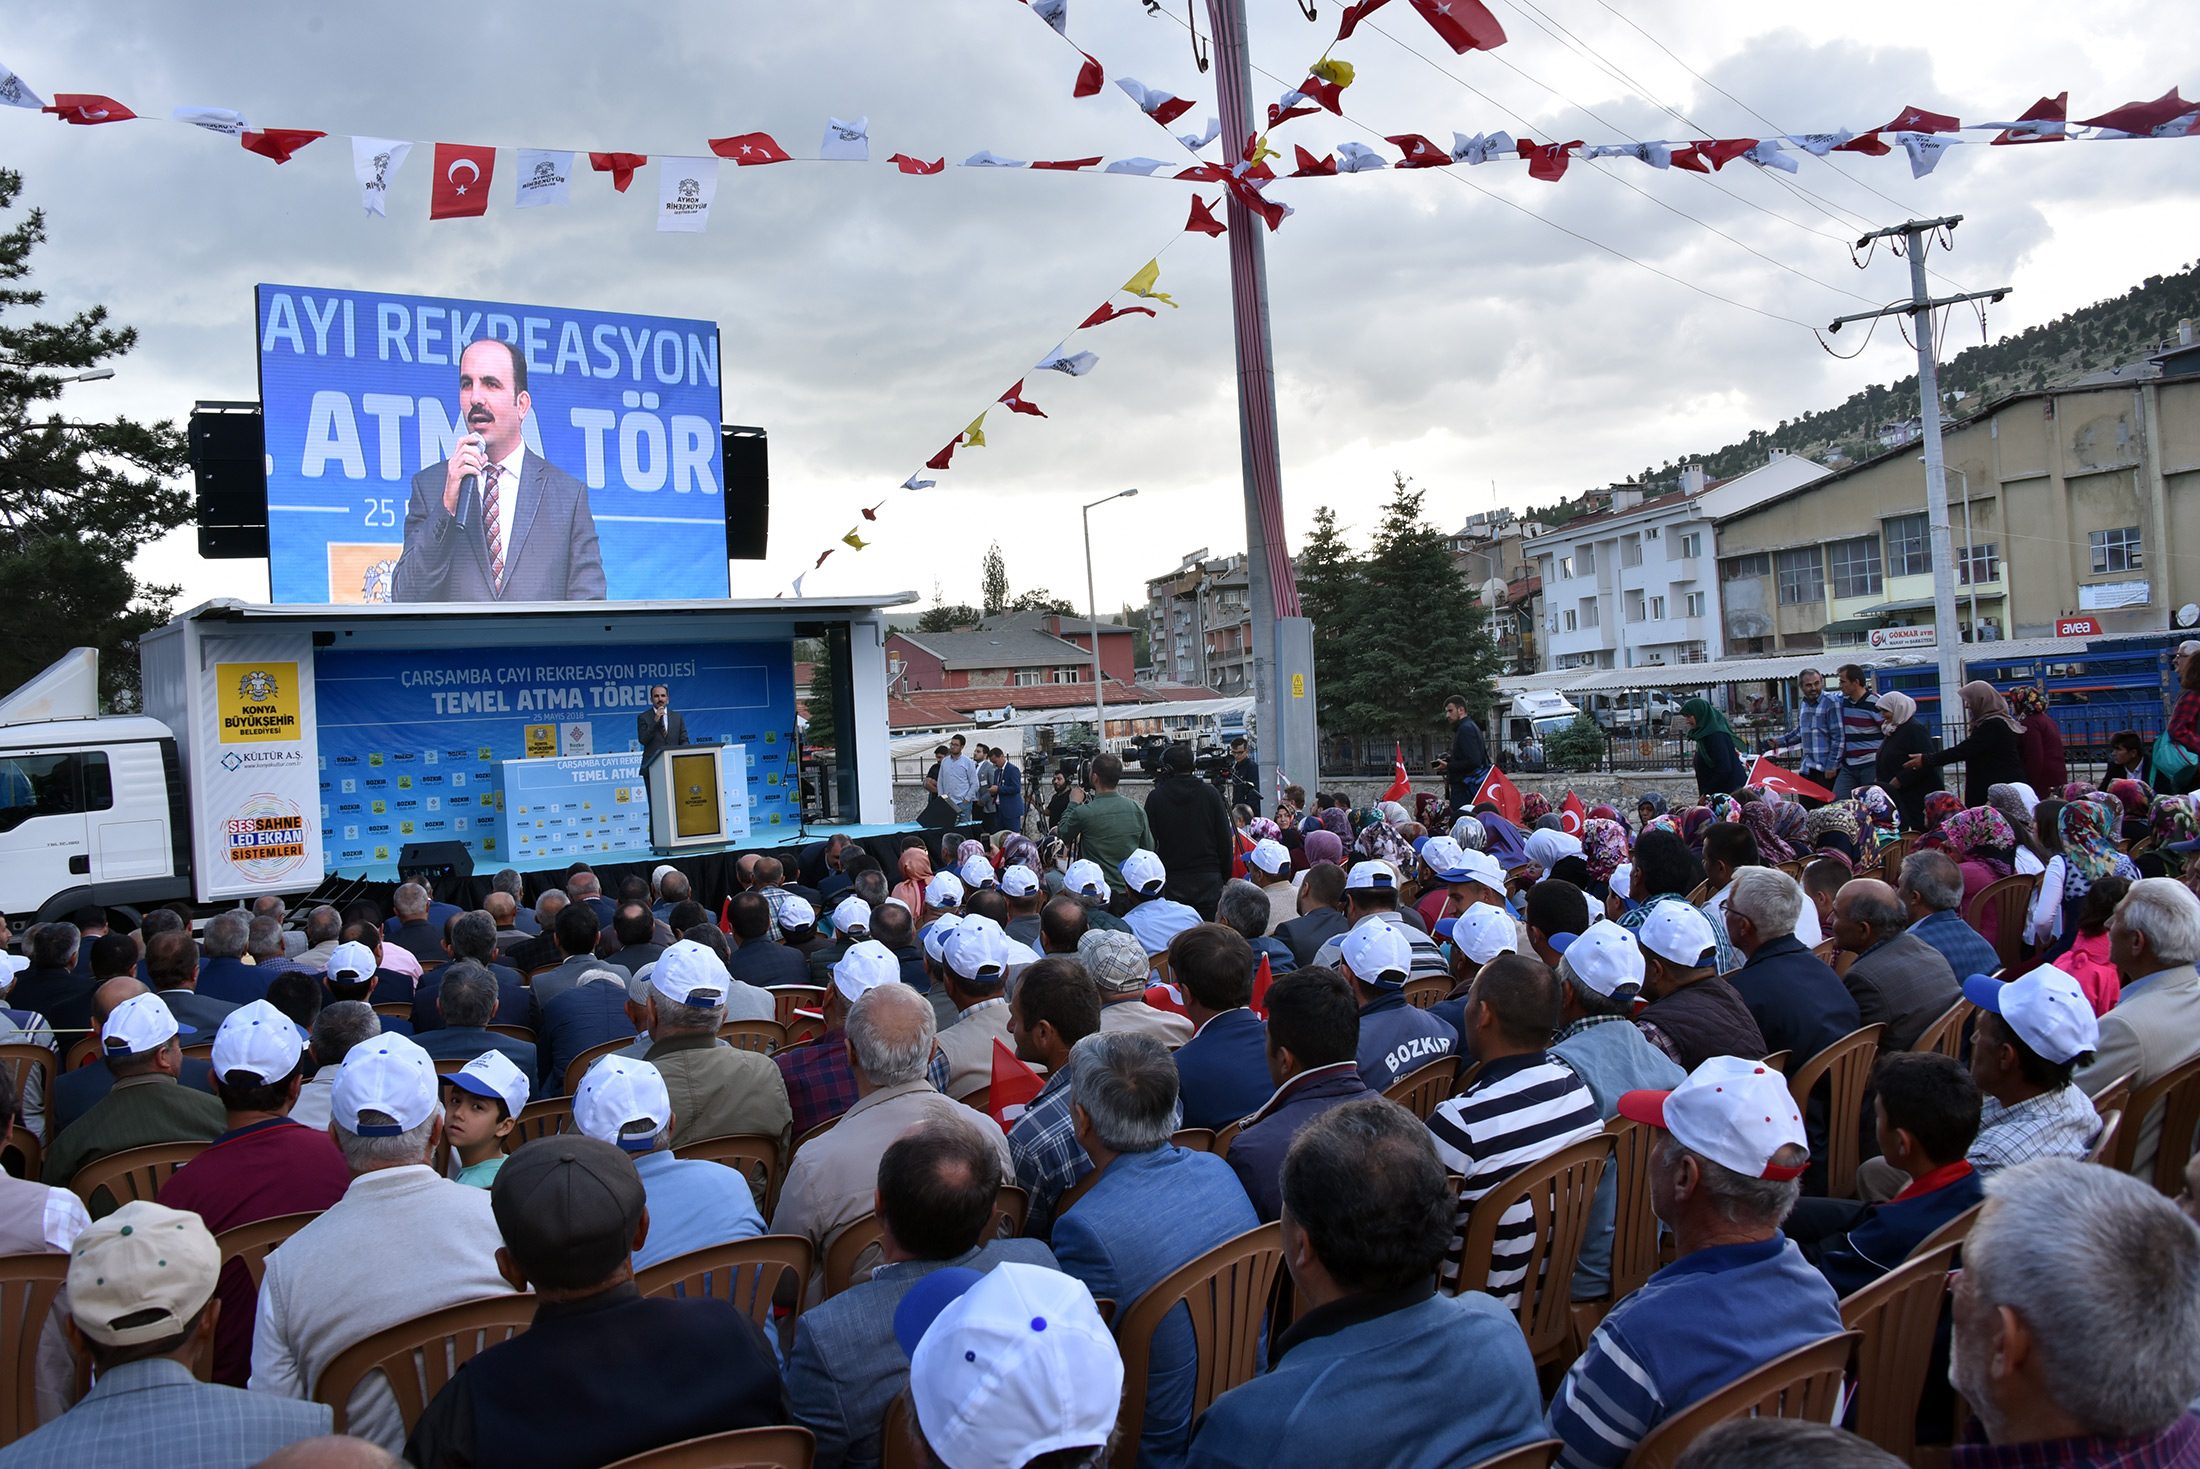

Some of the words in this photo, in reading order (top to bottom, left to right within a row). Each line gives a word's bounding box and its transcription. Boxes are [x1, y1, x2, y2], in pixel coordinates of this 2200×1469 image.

[262, 293, 357, 357] AYI
[570, 389, 719, 494] TÖR
[364, 498, 397, 528] 25
[1888, 630, 1918, 639] GÖKMAR
[2062, 622, 2091, 634] avea
[401, 668, 493, 688] ÇARŞAMBA
[496, 667, 532, 686] ÇAYI
[536, 664, 634, 682] REKREASYON
[639, 659, 696, 678] PROJESİ
[432, 690, 511, 715] TEMEL
[516, 687, 585, 711] ATMA
[242, 705, 277, 715] KONYA
[224, 714, 295, 728] BÜYÜKŞEHİR
[533, 714, 542, 722] 25
[544, 712, 565, 720] MAYIS
[566, 712, 584, 720] 2018
[240, 726, 282, 736] BELEDİYESİ
[243, 751, 284, 762] KÜLTÜR
[285, 750, 304, 760] A.Ş.
[557, 760, 600, 770] ÇARŞAMBA
[602, 758, 618, 767] ÇAYI
[571, 769, 608, 782] TEMEL
[450, 796, 470, 804] BOZKIR
[229, 820, 255, 832] SES
[256, 816, 301, 831] SAHNE
[368, 824, 389, 832] BOZKIR
[424, 820, 444, 828] BOZKIR
[230, 832, 255, 847] LED
[258, 830, 302, 845] EKRAN
[232, 845, 302, 860] SİSTEMLERİ
[1384, 1036, 1451, 1073] BOZKIR
